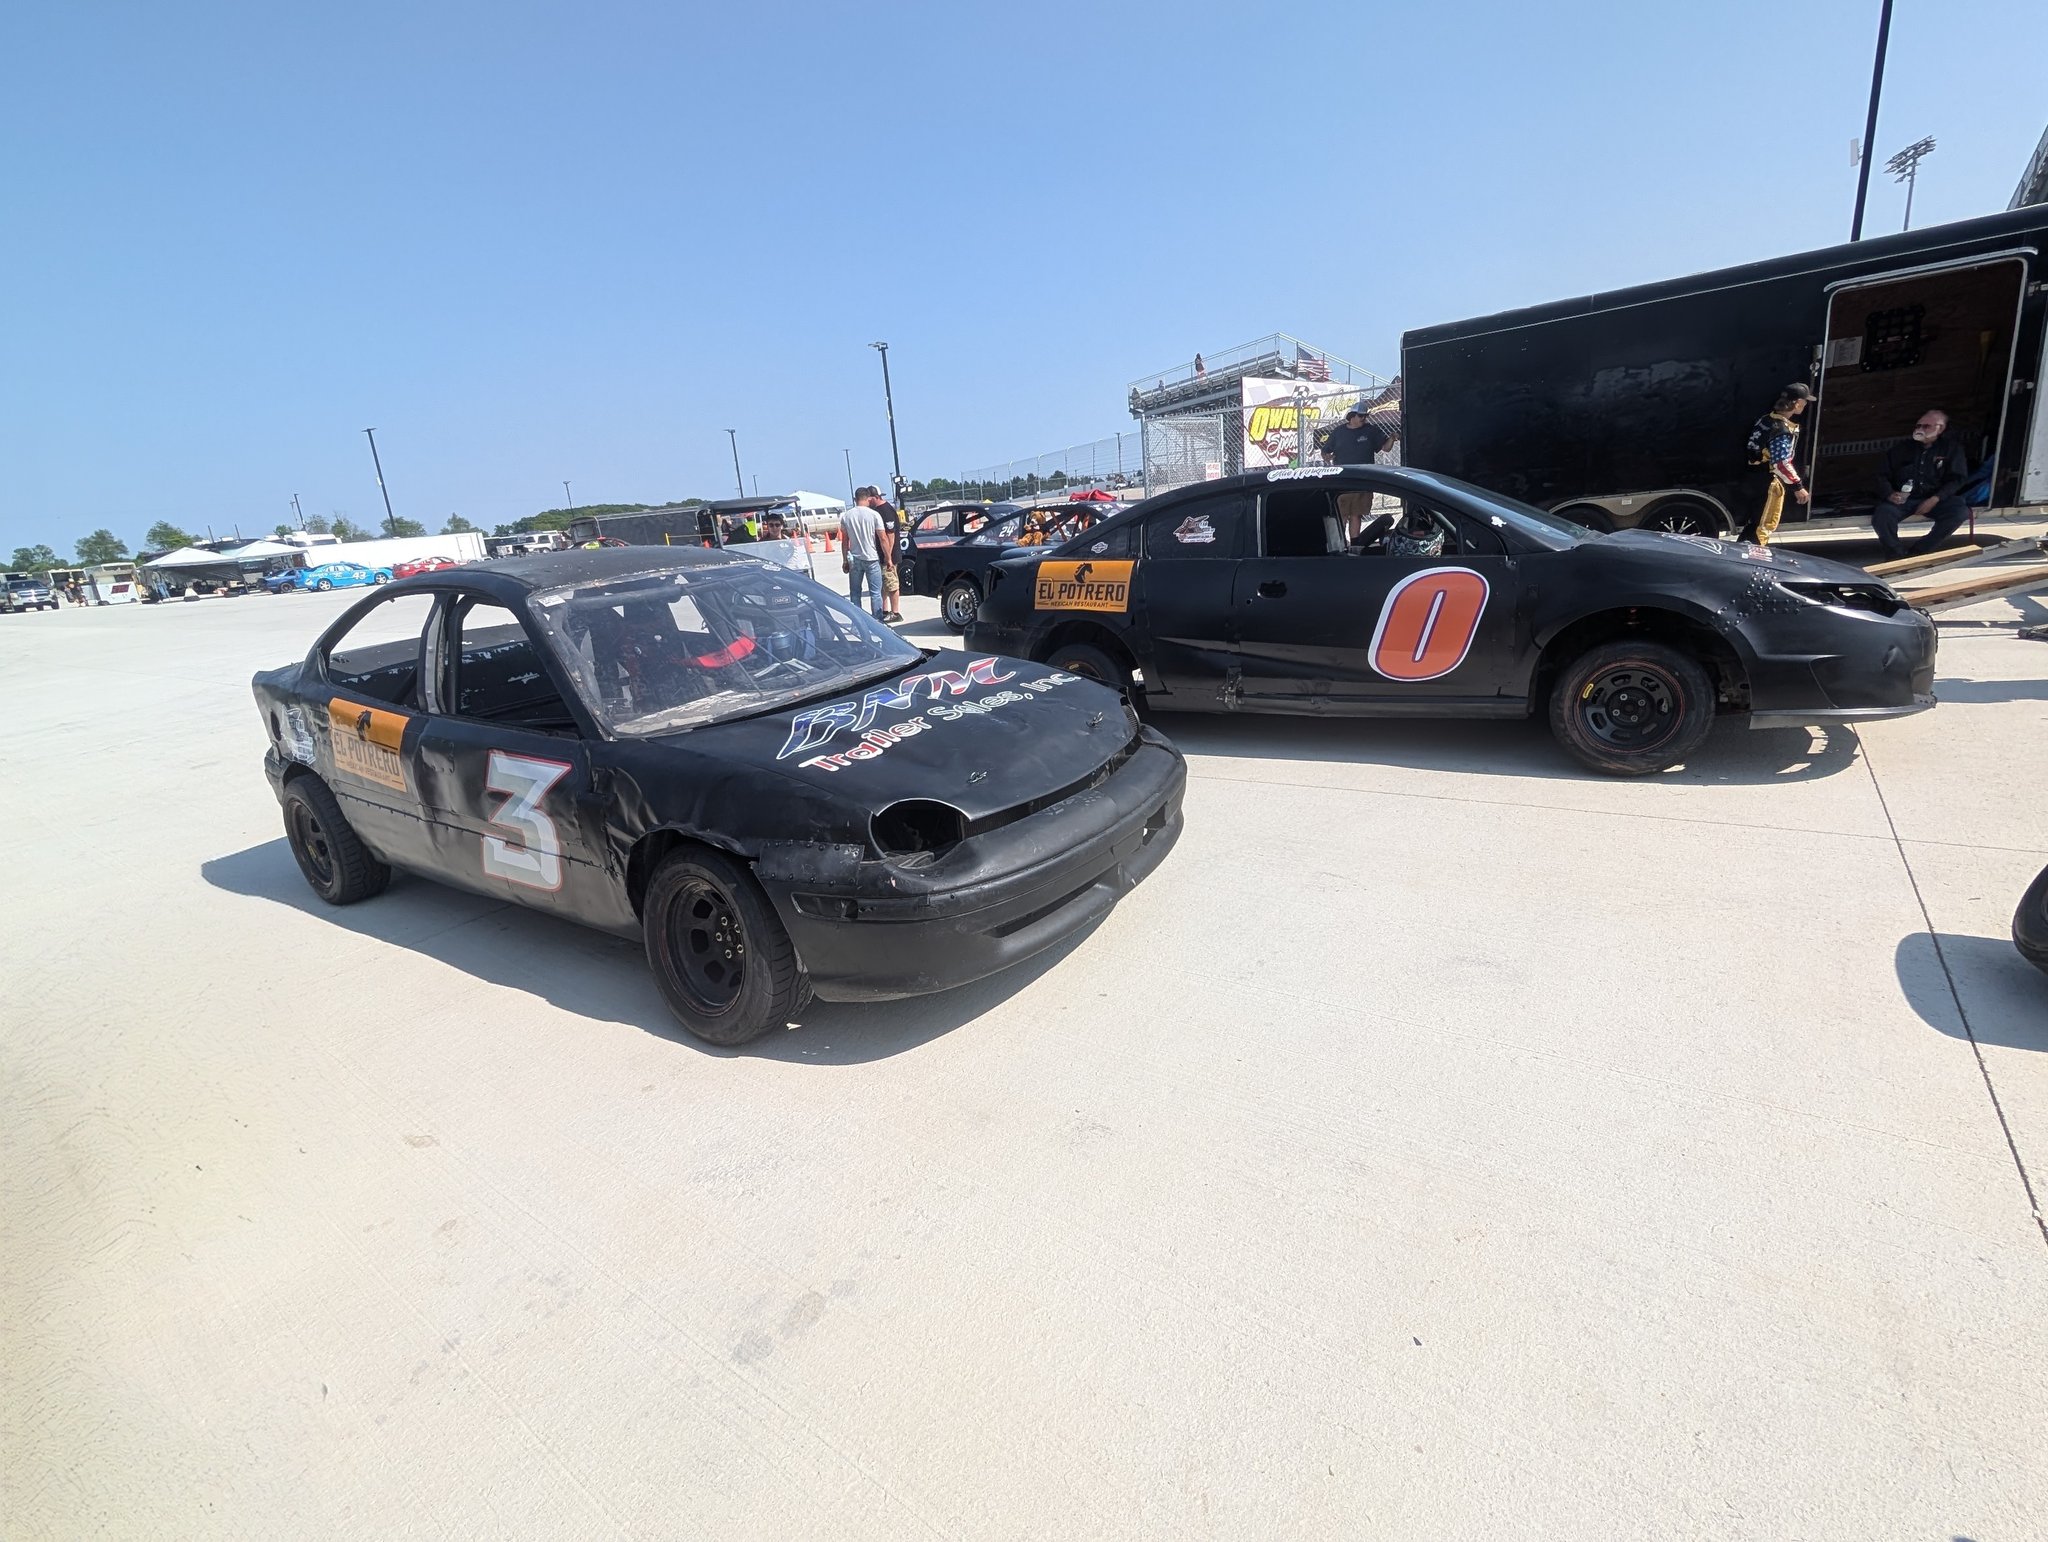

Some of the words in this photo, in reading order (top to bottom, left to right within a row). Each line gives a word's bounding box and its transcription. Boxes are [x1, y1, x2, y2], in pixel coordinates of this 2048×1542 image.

[999, 526, 1014, 538] 24
[352, 571, 367, 580] 43
[1038, 583, 1054, 600] EL
[1058, 584, 1126, 601] POTRERO
[1368, 566, 1490, 682] 0
[798, 716, 932, 772] Trailer
[927, 690, 1034, 721] Sales,
[1020, 672, 1083, 693] Inc.
[333, 731, 347, 756] EL
[348, 736, 400, 776] POTRERO
[481, 749, 572, 892] 3
